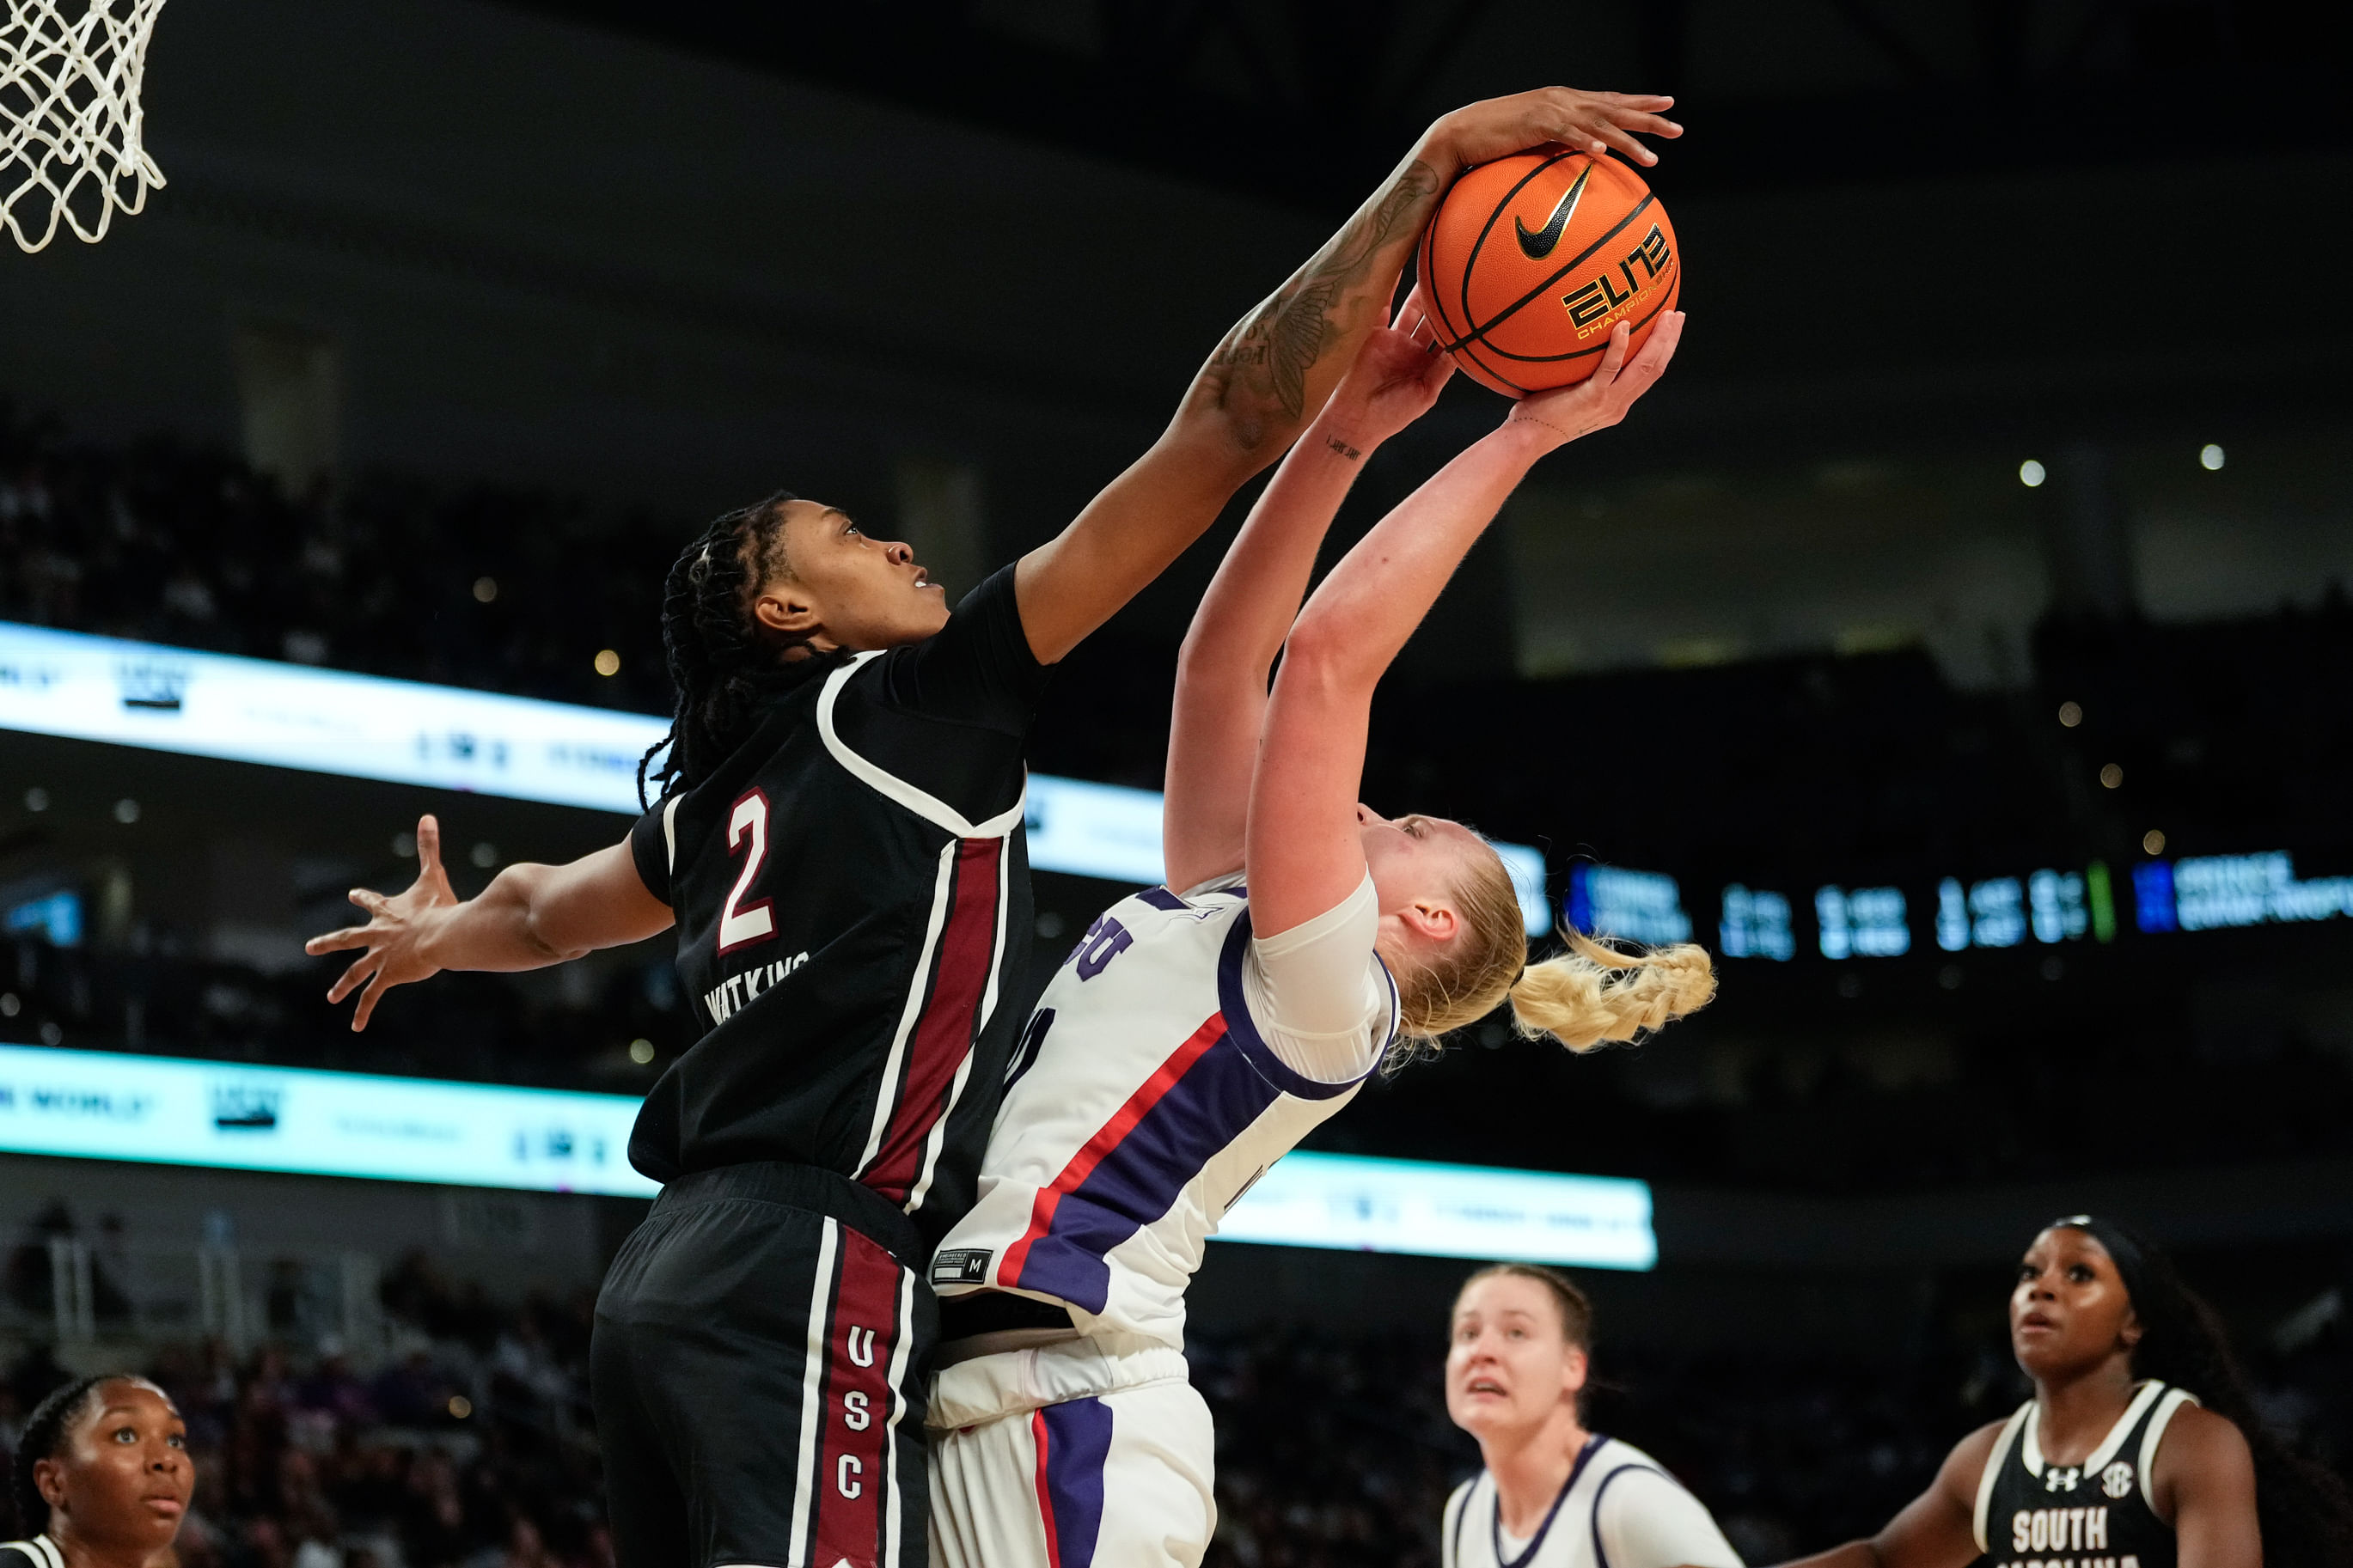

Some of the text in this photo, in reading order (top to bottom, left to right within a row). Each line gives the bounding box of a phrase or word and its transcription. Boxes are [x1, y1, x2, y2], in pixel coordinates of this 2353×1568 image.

[1561, 223, 1672, 330] ELITE
[717, 785, 779, 957] 2
[969, 1258, 982, 1273] M
[2013, 1505, 2108, 1553] SOUTH
